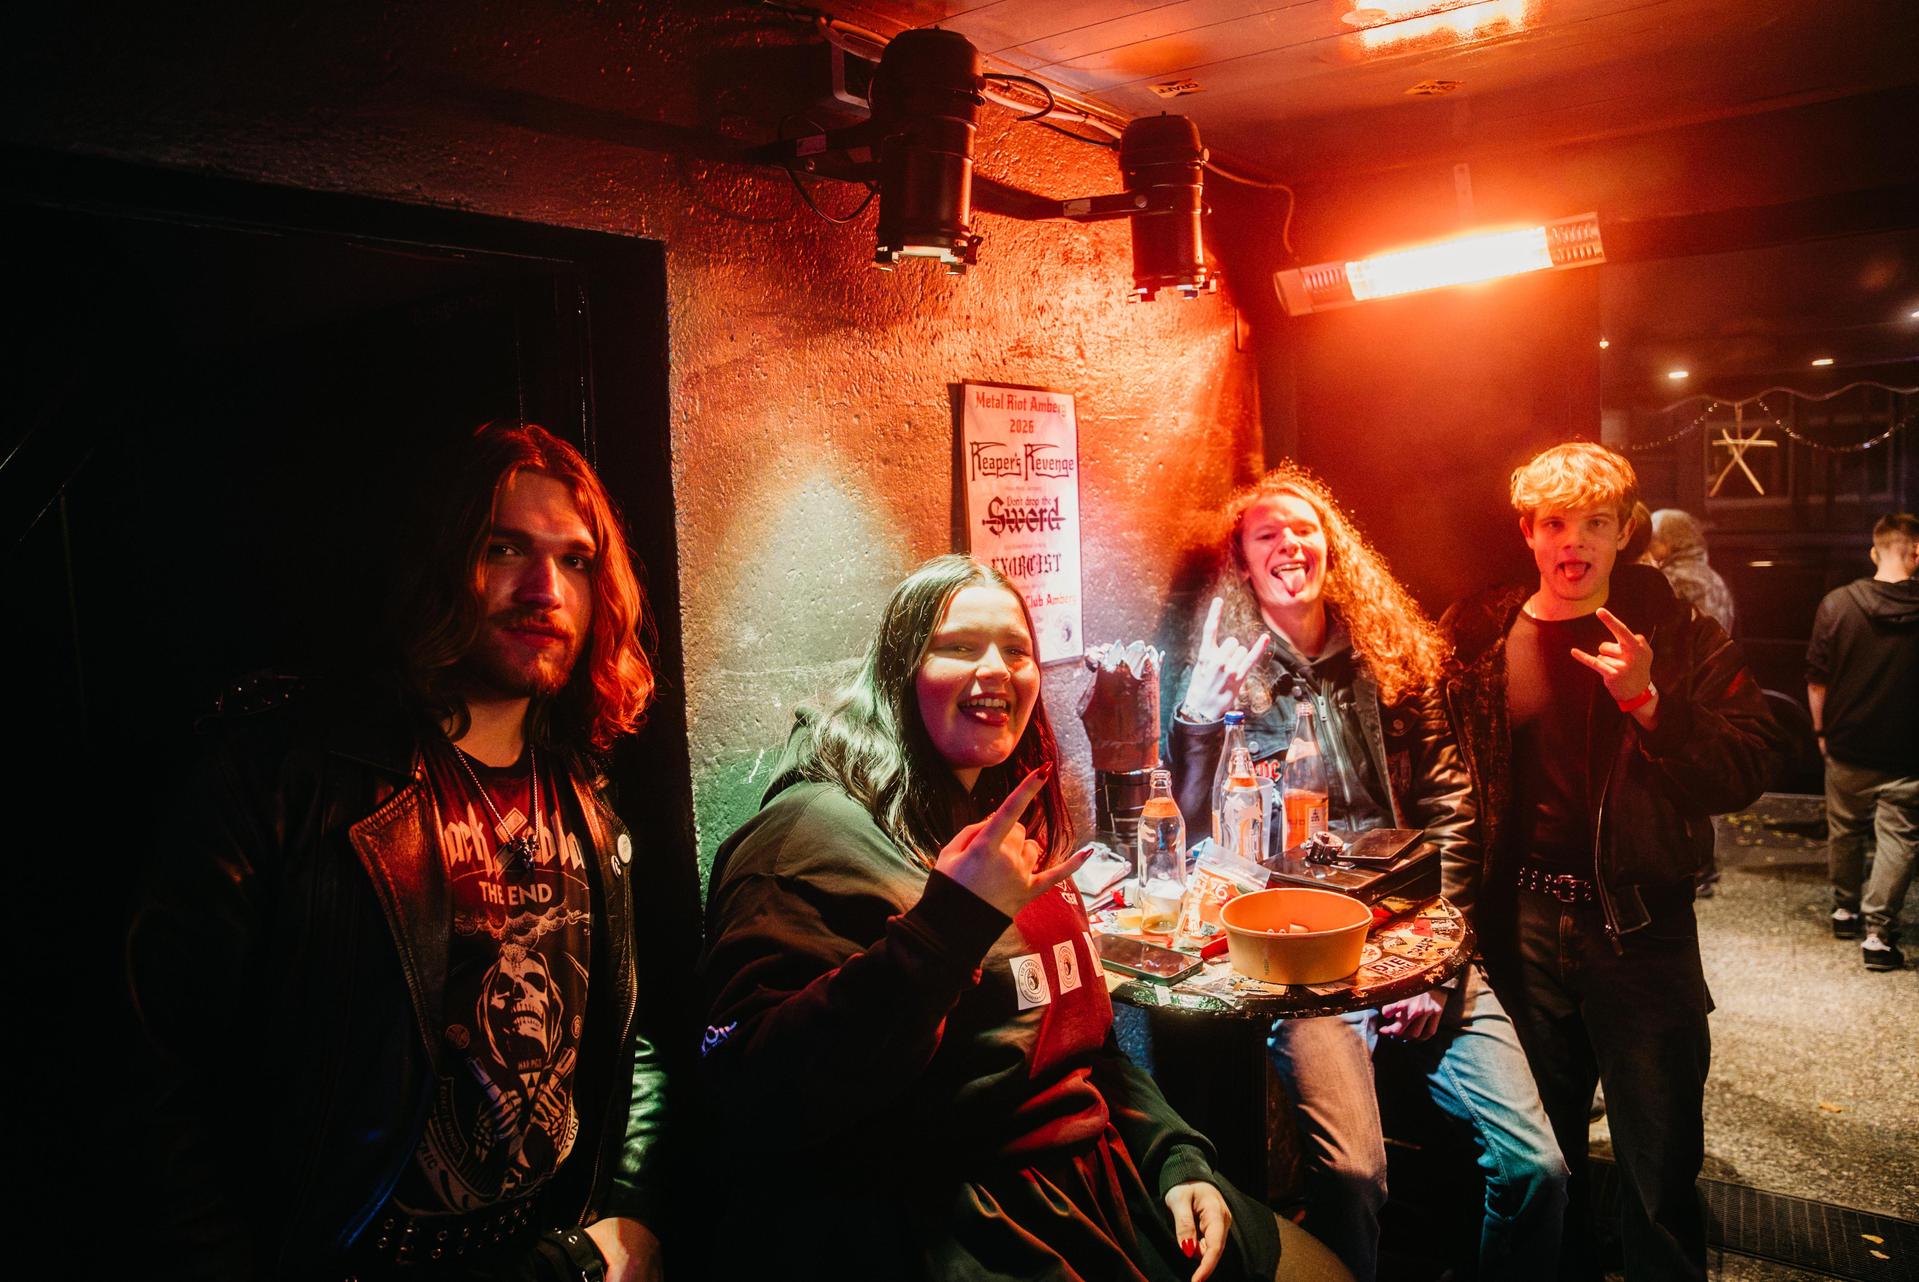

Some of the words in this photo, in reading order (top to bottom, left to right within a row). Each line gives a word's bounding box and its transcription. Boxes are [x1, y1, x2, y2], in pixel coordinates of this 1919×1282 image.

[976, 391, 1003, 410] Metal
[1007, 395, 1027, 411] Riot
[1030, 396, 1067, 417] Amberg
[1009, 419, 1035, 433] 2026
[970, 441, 1022, 481] Reaper's
[1024, 443, 1074, 481] Revenge
[1025, 496, 1039, 509] drop
[985, 496, 1063, 538] Sword
[1025, 594, 1043, 609] Club
[478, 881, 505, 906] THE
[508, 882, 553, 906] END
[1371, 957, 1406, 972] DIE
